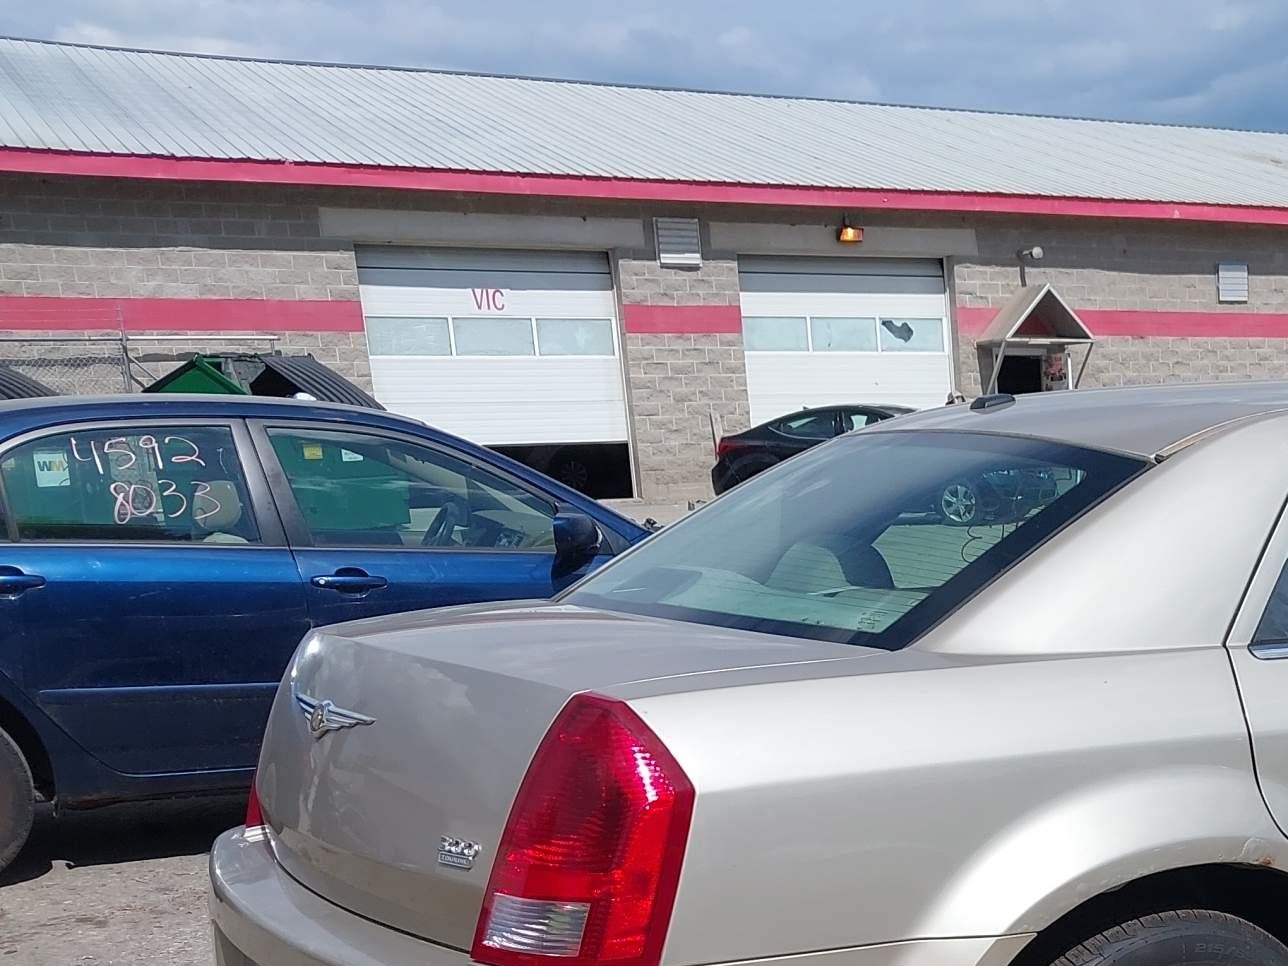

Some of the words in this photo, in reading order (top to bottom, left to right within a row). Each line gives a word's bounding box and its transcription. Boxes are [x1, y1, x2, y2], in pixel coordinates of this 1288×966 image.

[472, 288, 504, 311] VIC
[71, 435, 206, 475] 4592
[109, 479, 221, 524] 8033
